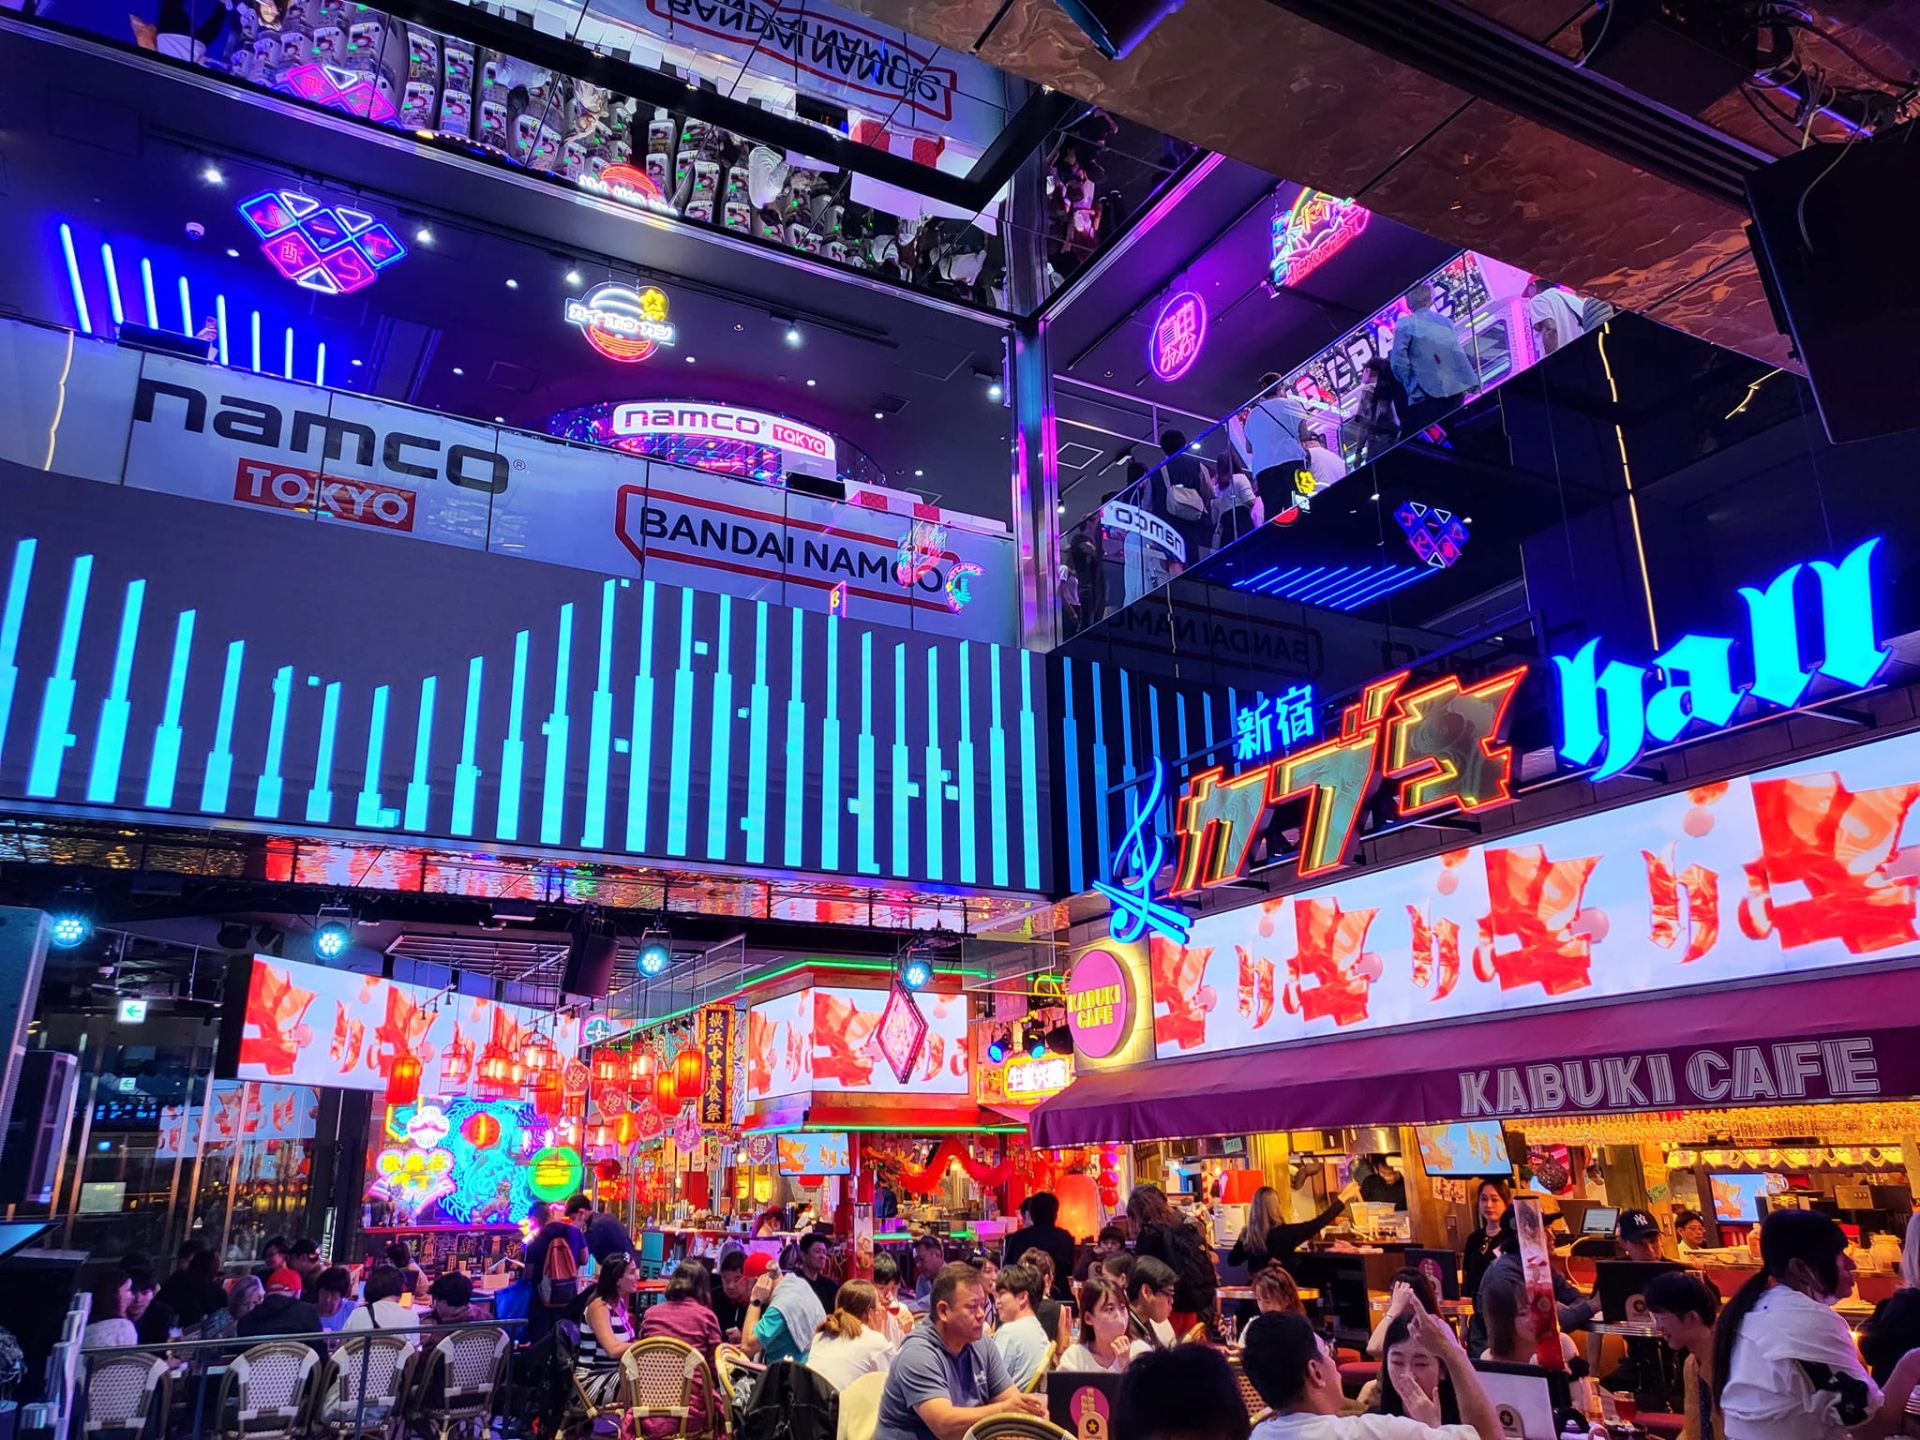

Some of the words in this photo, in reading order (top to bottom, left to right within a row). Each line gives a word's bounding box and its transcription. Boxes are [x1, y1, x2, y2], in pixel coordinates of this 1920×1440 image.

[134, 378, 510, 494] namco
[624, 409, 761, 436] namco
[775, 425, 826, 454] TOKYO
[246, 466, 409, 523] TOKYO
[640, 507, 793, 563] BANDAI
[1552, 536, 1892, 782] hall
[1236, 683, 1315, 763] 新宿
[1067, 983, 1120, 1013] KABUKI
[1077, 1004, 1114, 1029] CAFE
[706, 1012, 724, 1121] 横浜中華食祭
[1459, 1053, 1675, 1118] KABUKI
[1687, 1036, 1881, 1101] CAFE
